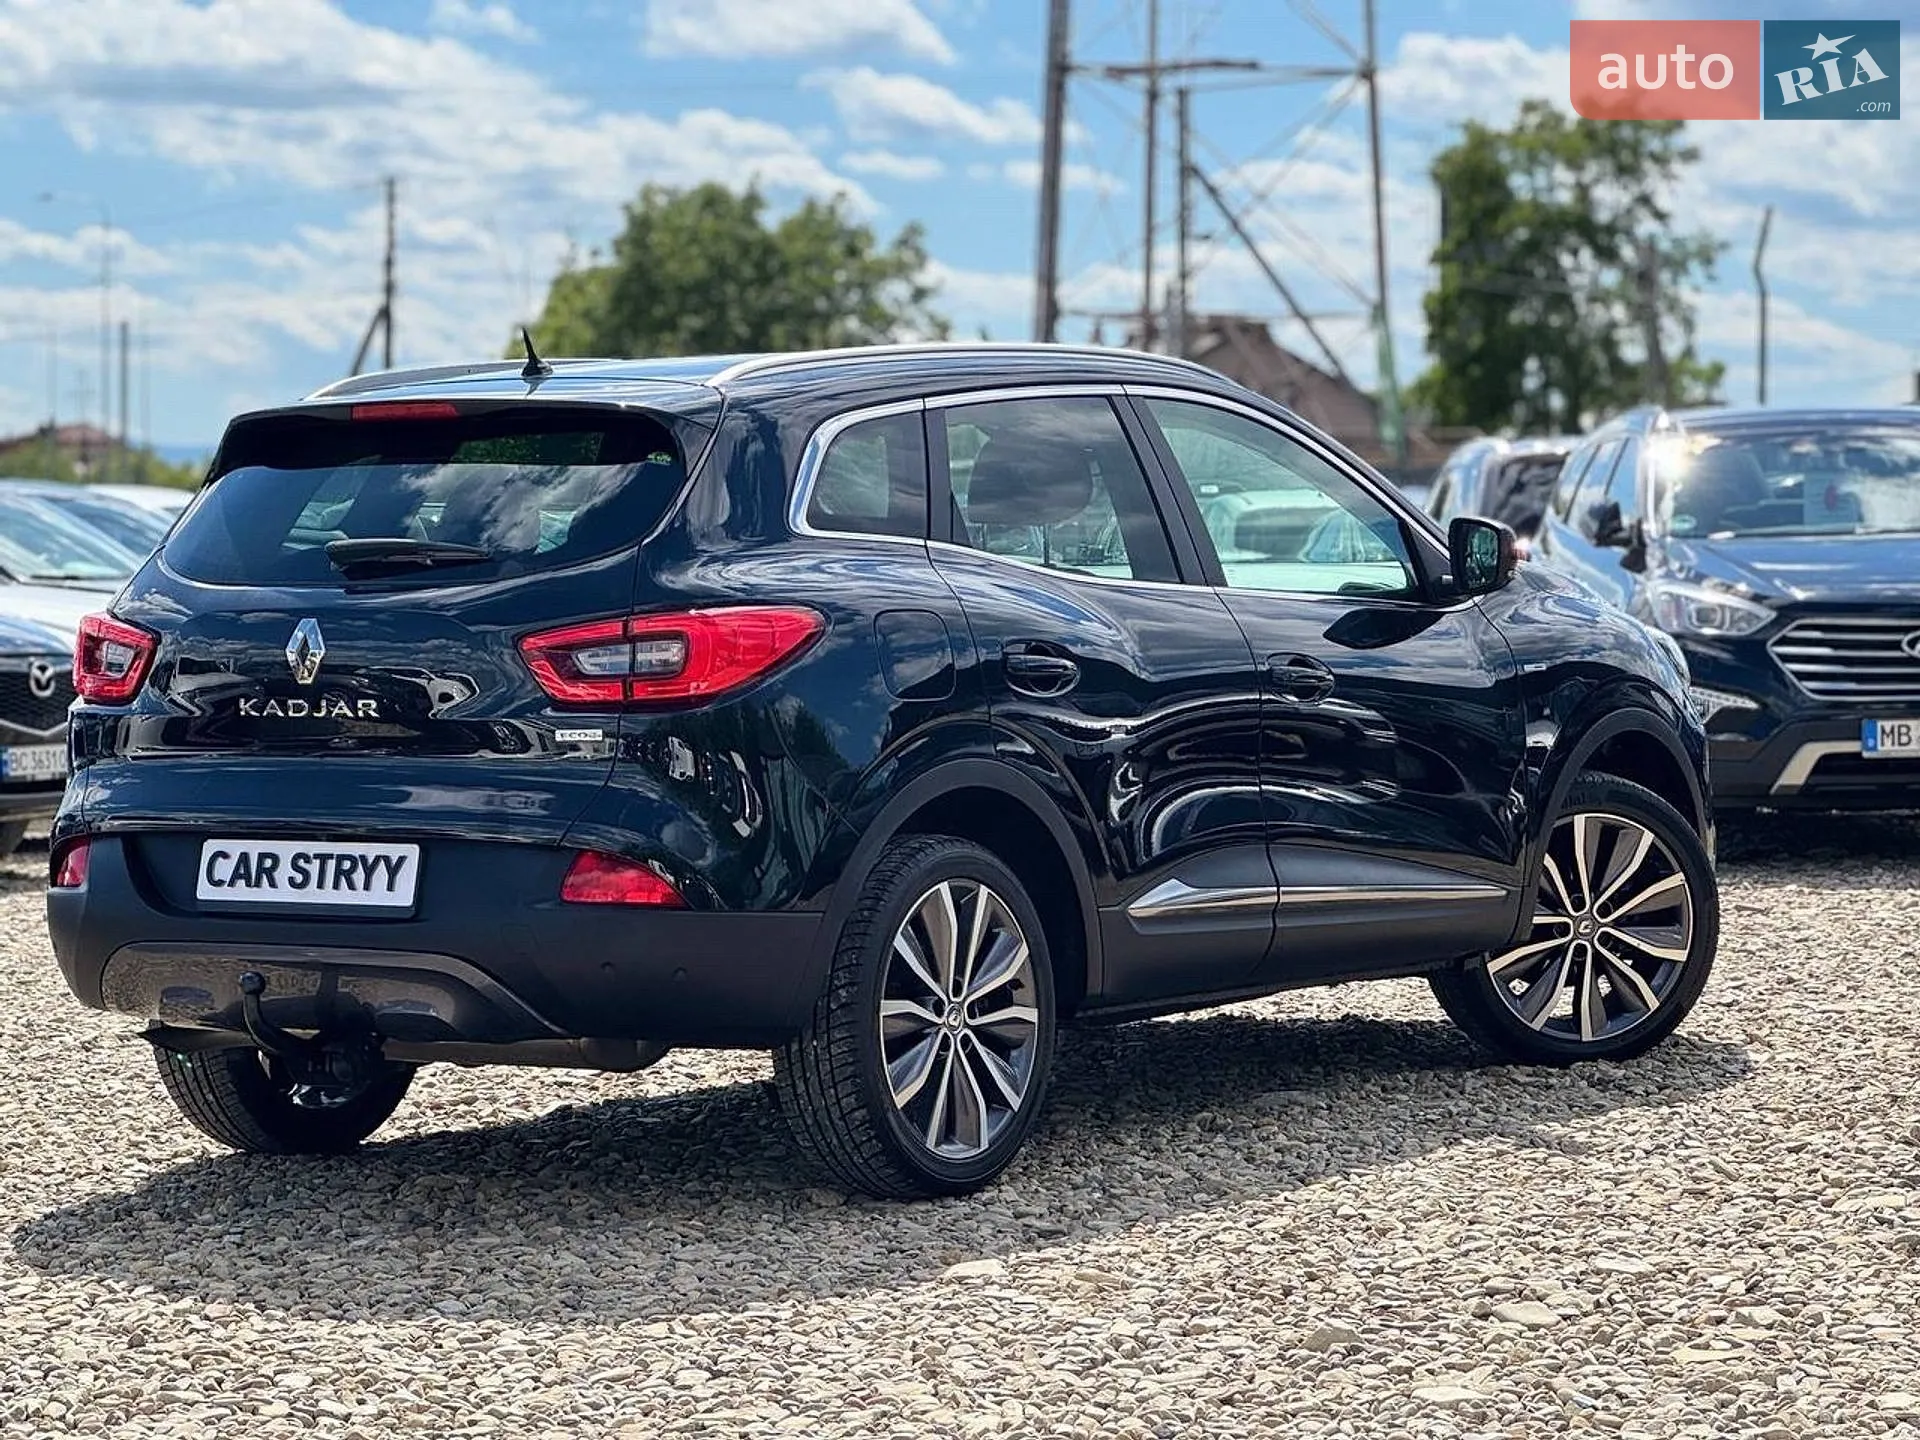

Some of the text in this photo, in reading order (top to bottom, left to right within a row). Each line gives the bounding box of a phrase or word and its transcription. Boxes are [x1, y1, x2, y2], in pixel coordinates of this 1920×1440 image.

[238, 698, 381, 718] KADJAR
[1880, 724, 1912, 747] MB
[205, 850, 407, 892] CAR STRYY
